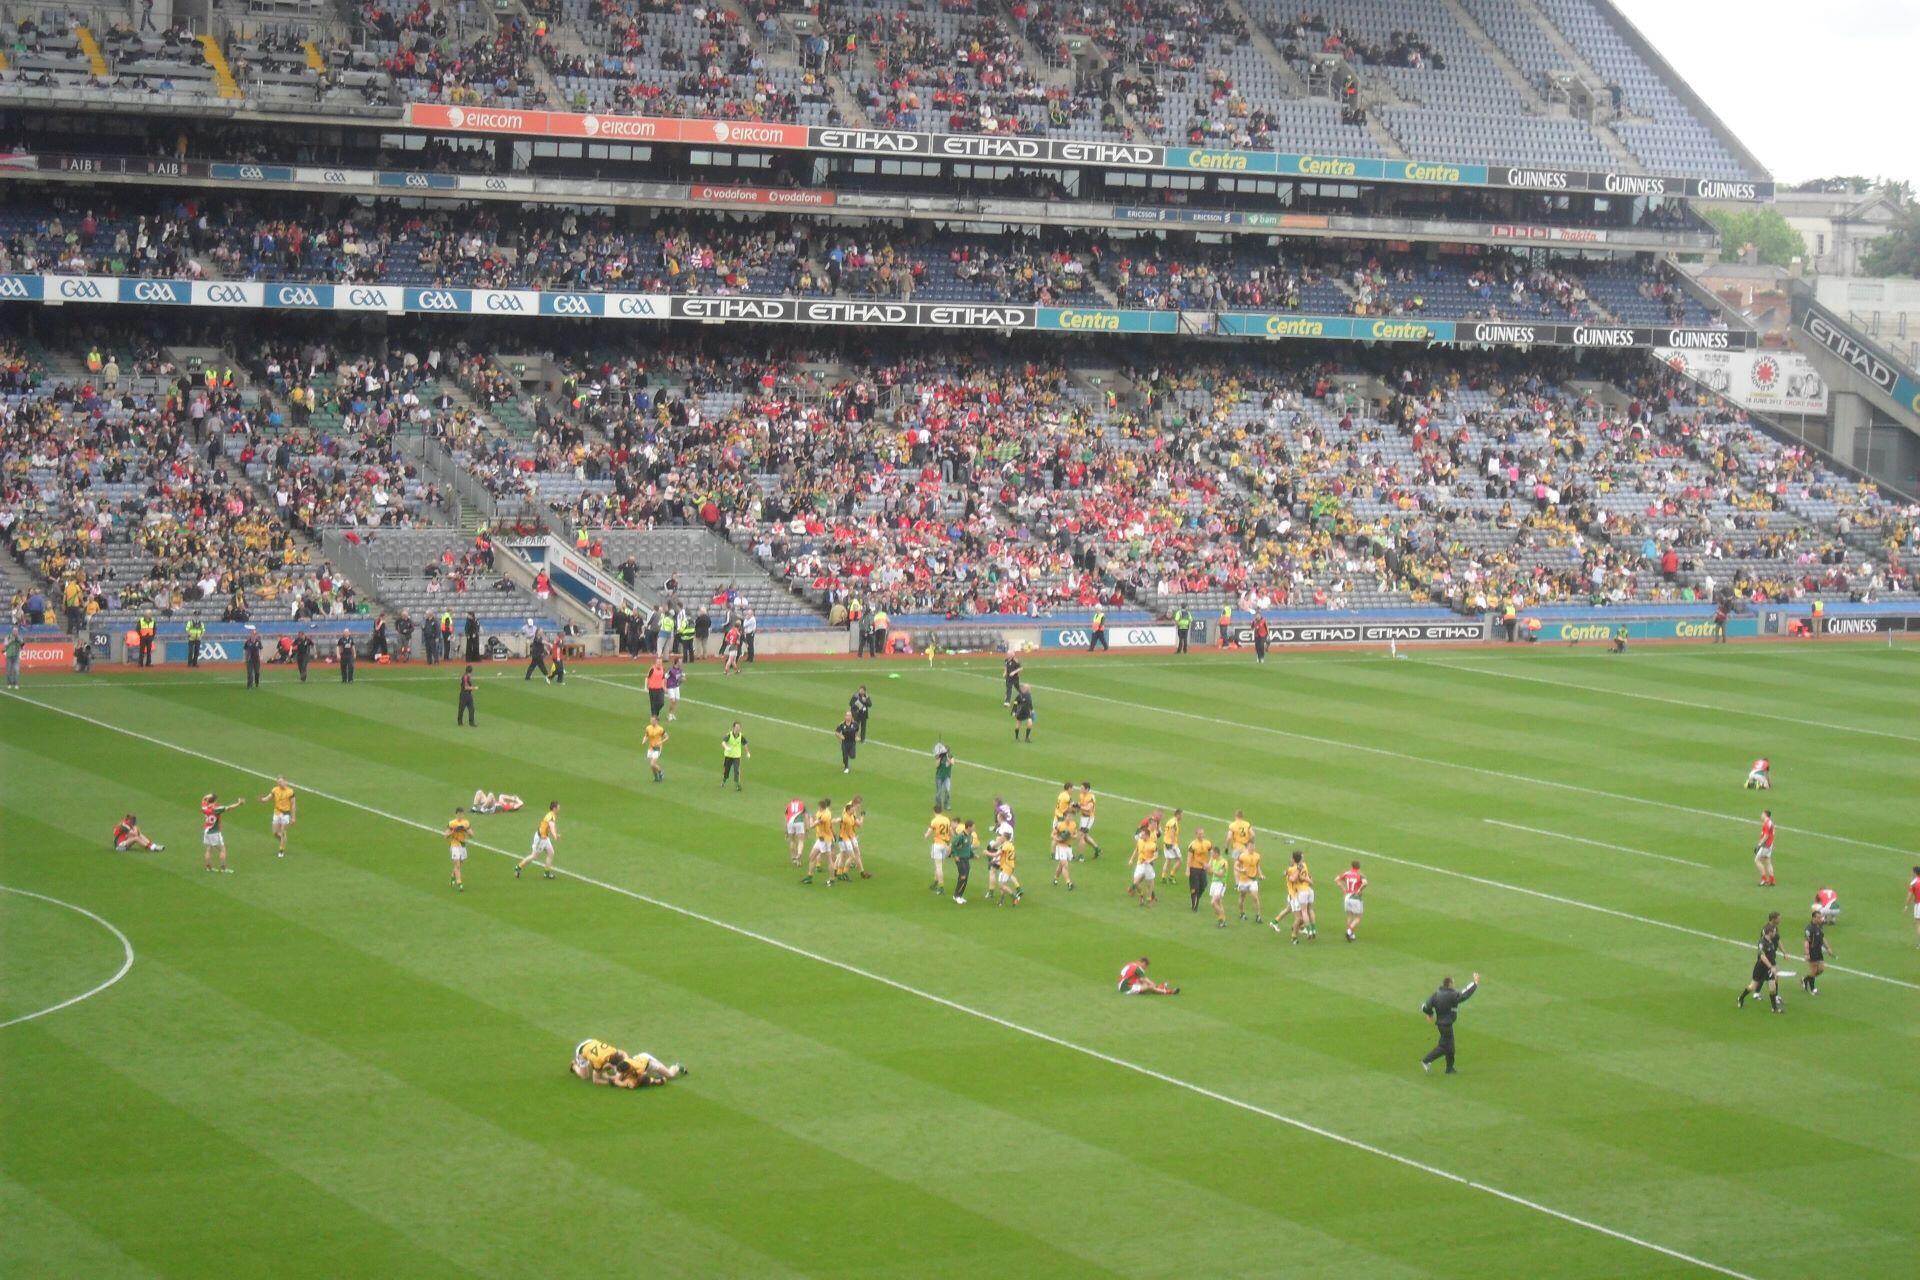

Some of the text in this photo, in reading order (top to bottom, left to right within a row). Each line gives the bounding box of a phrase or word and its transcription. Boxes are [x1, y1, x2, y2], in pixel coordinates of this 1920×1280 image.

[820, 131, 918, 151] ETIHAD
[943, 137, 1039, 158] ETIHAD
[1062, 143, 1154, 164] ETIHAD
[1188, 150, 1248, 171] Centra
[70, 159, 92, 171] AIB
[157, 163, 179, 174] AIB
[239, 166, 264, 180] GAA
[1298, 156, 1356, 176] Centra
[1404, 162, 1460, 182] Centra
[323, 170, 347, 183] GAA
[405, 174, 429, 188] GAA
[485, 178, 507, 191] GAA
[1507, 168, 1567, 189] GUINNESS
[1605, 173, 1664, 195] GUINNESS
[713, 189, 758, 200] vodafone
[1697, 178, 1755, 199] GUINNESS
[779, 194, 822, 204] vodafone
[1127, 210, 1157, 220] ERICSSON
[1193, 213, 1222, 223] ERICSSON
[0, 278, 29, 297] AA
[60, 279, 102, 299] GAA
[135, 281, 177, 301] GAA
[206, 284, 248, 304] GAA
[279, 286, 319, 306] GAA
[349, 289, 388, 308] GAA
[418, 291, 458, 310] GAA
[486, 293, 525, 312] GAA
[553, 295, 592, 314] GAA
[618, 297, 656, 315] GAA
[682, 300, 784, 319] ETIHAD
[808, 303, 907, 323] ETIHAD
[930, 306, 1025, 325] ETIHAD
[1059, 309, 1120, 330] Centra
[1266, 316, 1323, 337] Centra
[1372, 321, 1428, 339] Centra
[1475, 323, 1534, 343] GUINNESS
[1573, 326, 1634, 346] GUINNESS
[1669, 328, 1728, 348] GUINNESS
[1810, 318, 1890, 386] ETIHAD
[1300, 628, 1356, 640] ETIHAD
[1366, 626, 1480, 639] ETIHAD ETIHAD
[1560, 623, 1610, 640] Centra
[1827, 617, 1878, 633] GUINNESS
[94, 635, 107, 645] 30
[1059, 630, 1090, 647] GAA
[1128, 630, 1158, 646] GAA
[939, 824, 949, 835] 21
[1346, 877, 1358, 891] 17
